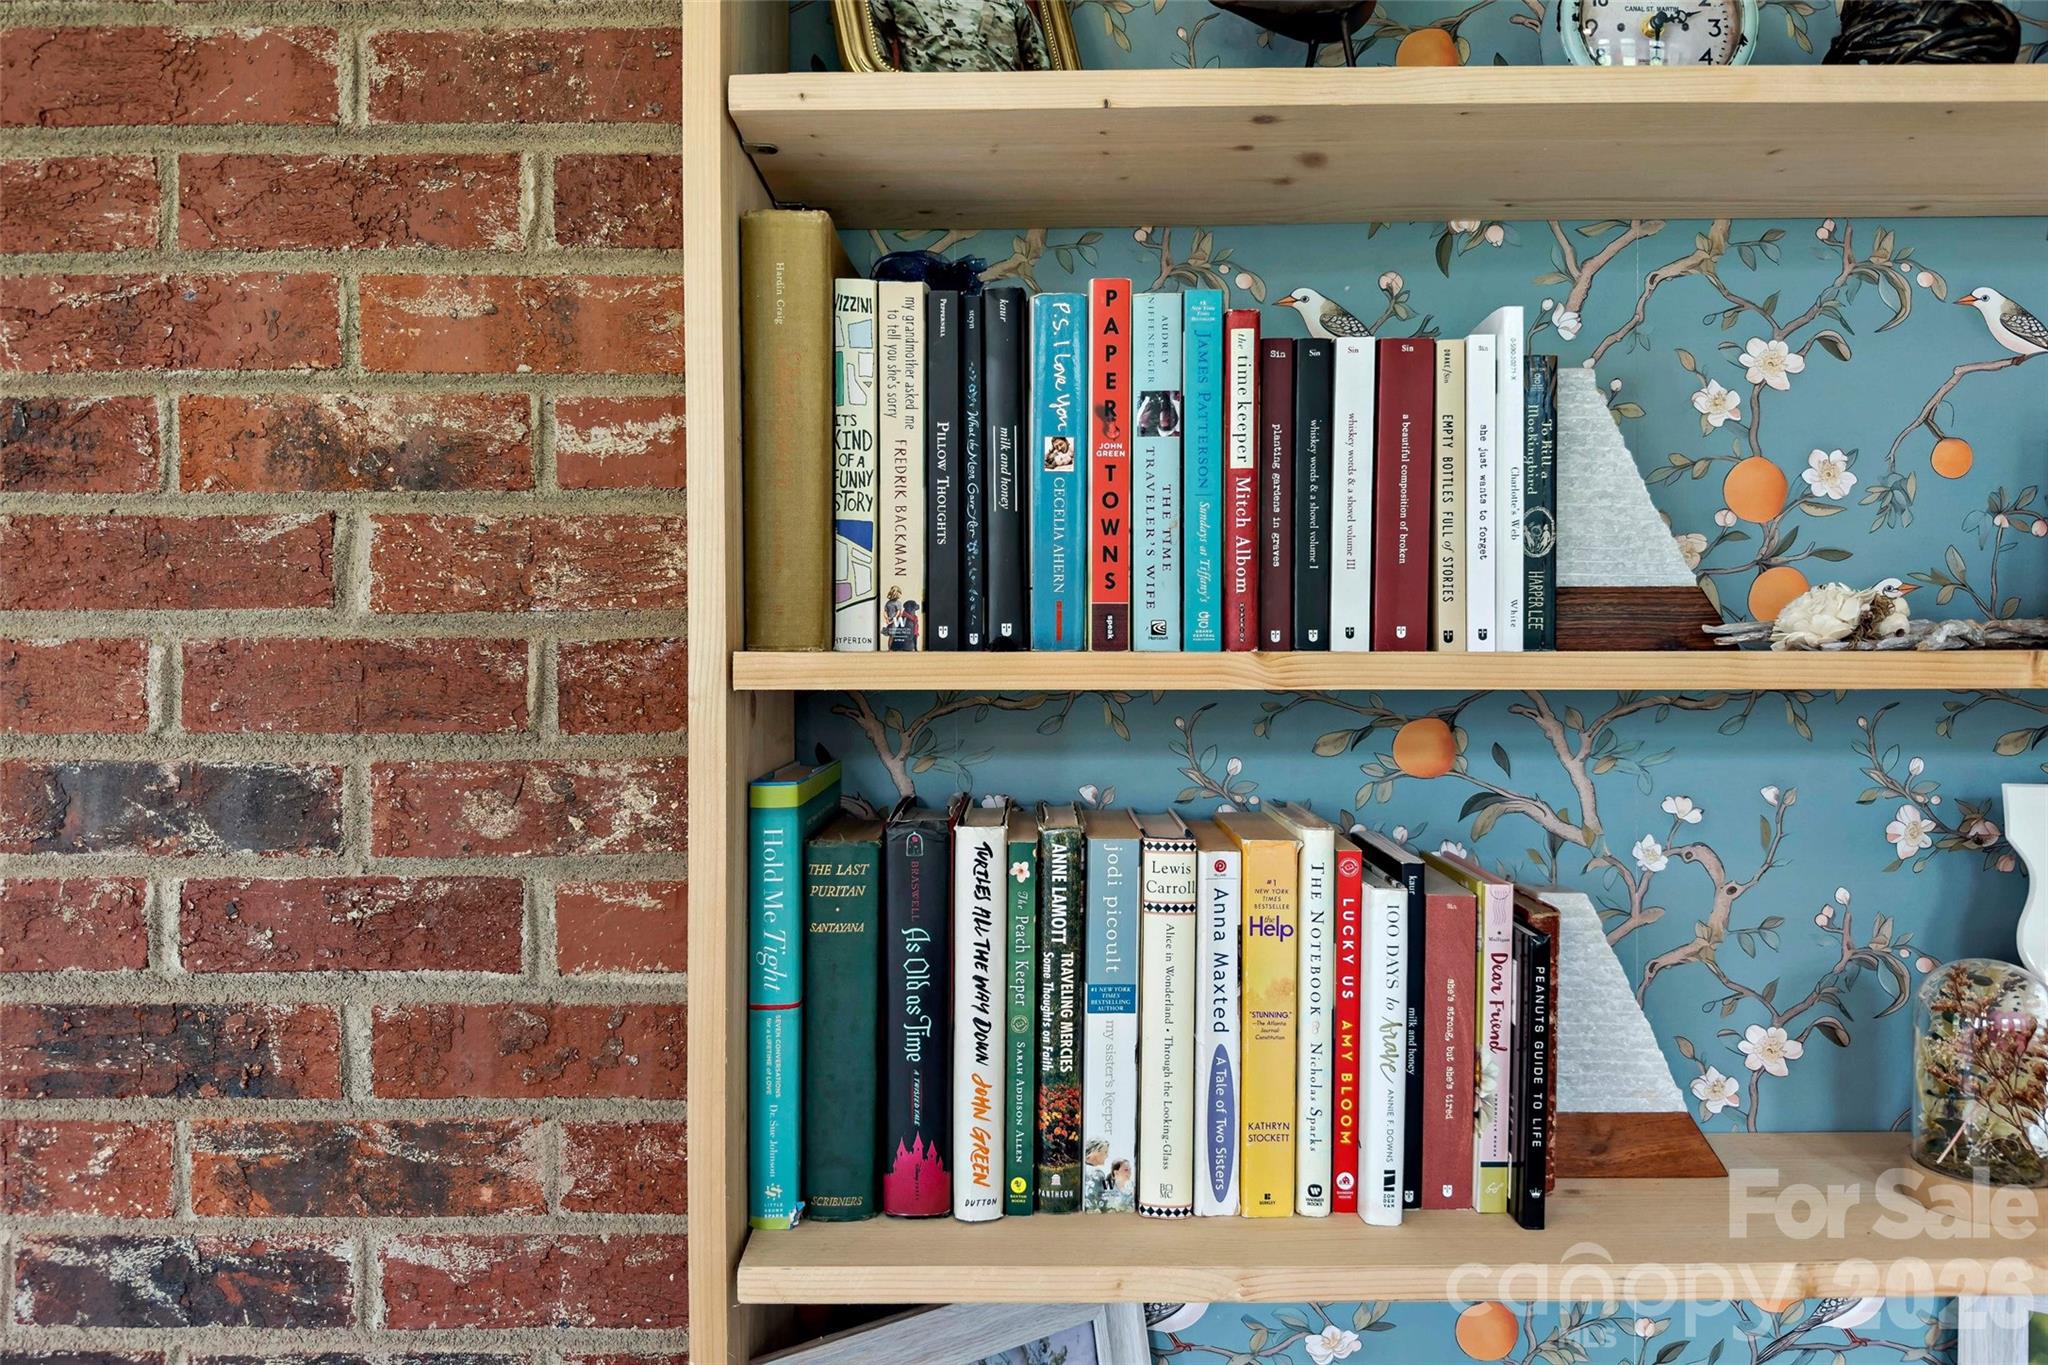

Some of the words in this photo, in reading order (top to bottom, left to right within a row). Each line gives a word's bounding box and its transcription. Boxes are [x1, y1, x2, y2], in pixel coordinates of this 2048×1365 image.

[1707, 18, 1721, 37] 3
[1698, 48, 1713, 65] 4
[776, 261, 785, 295] Hardin
[773, 299, 785, 325] Craig
[902, 297, 916, 311] my
[999, 298, 1009, 323] kaur
[1052, 302, 1071, 336] P.S.
[887, 325, 900, 340] tell
[902, 315, 918, 379] grandmother
[1401, 344, 1414, 352] Sin
[884, 344, 897, 361] you
[1103, 289, 1120, 421] PAPER
[1194, 330, 1211, 384] JAMES
[1270, 350, 1286, 358] Sin
[1309, 349, 1321, 357] Sin
[1053, 353, 1073, 391] Love
[1237, 355, 1251, 396] time
[883, 392, 897, 418] sorry
[905, 382, 918, 410] asked
[1048, 394, 1071, 432] You
[905, 416, 916, 430] me
[967, 411, 979, 437] What
[999, 427, 1011, 451] milk
[1197, 392, 1211, 489] PATTERSON
[1232, 401, 1253, 463] keeper
[1401, 422, 1410, 462] beautiful
[1442, 414, 1454, 449] EMPTY
[1479, 424, 1488, 442] she
[1000, 453, 1011, 476] and
[1099, 442, 1123, 450] JOHN
[1477, 447, 1488, 469] just
[1522, 404, 1539, 495] Mockingbird
[894, 439, 907, 499] FREDRIK
[1309, 484, 1319, 492] &
[1442, 456, 1454, 503] BOTTLES
[998, 477, 1011, 510] honey
[1162, 484, 1172, 520] THE
[1235, 476, 1252, 528] Mitch
[1397, 464, 1409, 518] composition
[1479, 474, 1487, 504] wants
[1053, 477, 1066, 540] CECELIA
[1100, 464, 1120, 591] TOWNS
[1197, 501, 1210, 542] Sundays
[1442, 511, 1454, 538] FULL
[894, 505, 907, 576] BACKMAN
[1162, 527, 1172, 572] TIME
[1399, 533, 1408, 564] broken
[1477, 526, 1488, 560] forget
[1053, 543, 1065, 593] AHERN
[1235, 535, 1252, 594] Albom
[1442, 556, 1454, 603] STORIES
[1146, 565, 1156, 610] WIFE
[1527, 571, 1545, 609] HARPER
[1106, 615, 1115, 639] speak
[1527, 610, 1545, 631] LEE
[763, 827, 784, 883] Hold
[808, 863, 832, 876] THE
[835, 863, 870, 876] LAST
[973, 841, 994, 901] TURTLES
[1051, 842, 1067, 883] ANNE
[1103, 844, 1123, 888] jodi
[1151, 860, 1192, 874] Lewis
[809, 885, 866, 897] PURITAN
[911, 860, 920, 923] BRASWELL
[1146, 880, 1195, 894] Carroll
[1311, 862, 1325, 900] THE
[1408, 875, 1418, 895] kaur
[763, 889, 784, 923] Me
[1051, 886, 1067, 944] LAMOTT
[1213, 888, 1229, 942] Anna
[809, 922, 865, 933] SANTAYANA
[1014, 915, 1031, 953] Peach
[1103, 895, 1122, 973] picoult
[1164, 923, 1175, 950] Alice
[1249, 915, 1294, 942] Help
[1342, 898, 1355, 964] LUCKY
[756, 928, 788, 992] Tight
[903, 957, 931, 991] Old
[974, 938, 991, 972] THE
[1043, 951, 1055, 979] Some
[1311, 911, 1325, 1016] NOTEBOOK
[1386, 945, 1399, 989] DAYS
[1490, 952, 1509, 996] Dear
[971, 974, 992, 1014] WAY
[1009, 960, 1029, 1006] Keeper
[1060, 951, 1074, 1018] TRAVELING
[1164, 965, 1174, 1025] Wonderland
[1213, 952, 1230, 1033] Maxted
[1342, 975, 1354, 999] US
[1534, 966, 1546, 1033] PEANUTS
[1039, 982, 1055, 1028] Thoughts
[903, 1015, 933, 1062] Time
[972, 1017, 992, 1066] DOWN
[1103, 1019, 1115, 1041] my
[1341, 1020, 1353, 1061] AMY
[1407, 1029, 1417, 1046] and
[1489, 999, 1508, 1054] Friend
[1041, 1046, 1053, 1071] Faith
[1060, 1021, 1074, 1072] MERCIES
[1162, 1035, 1174, 1079] Through
[1380, 1016, 1404, 1084] brave
[1405, 1048, 1417, 1076] honey
[1533, 1041, 1544, 1085] GUIDE
[1104, 1044, 1116, 1088] sister's
[1215, 1068, 1227, 1096] Tale
[1310, 1042, 1323, 1101] Nicholas
[971, 1072, 993, 1122] JOHN
[1163, 1081, 1173, 1097] the
[1215, 1099, 1227, 1113] of
[1386, 1088, 1395, 1117] ANNIE
[1532, 1092, 1543, 1110] TO
[1102, 1092, 1116, 1136] keeper
[1247, 1122, 1290, 1131] KATHRYN
[1339, 1072, 1352, 1145] BLOOM
[1161, 1100, 1173, 1171] Looking-Glass
[1215, 1117, 1226, 1143] Two
[1248, 1134, 1290, 1143] STOCKETT
[1306, 1106, 1323, 1152] Sparks
[1385, 1128, 1394, 1163] DOWNS
[1532, 1117, 1542, 1147] LIFE
[970, 1127, 992, 1187] GREEN
[1215, 1147, 1227, 1191] Sisters
